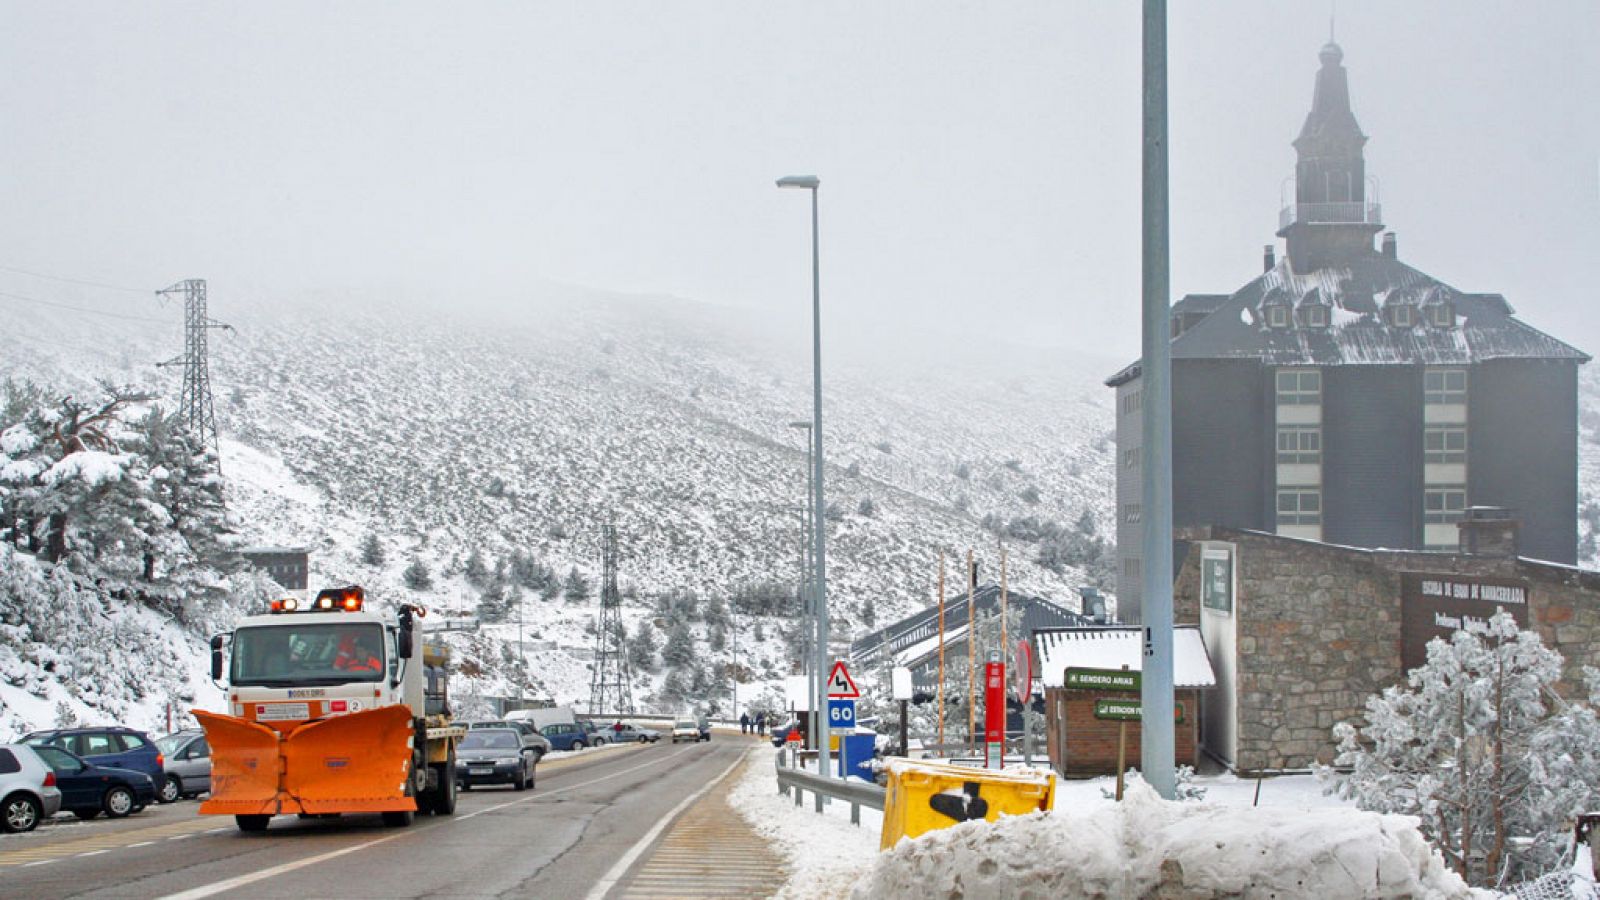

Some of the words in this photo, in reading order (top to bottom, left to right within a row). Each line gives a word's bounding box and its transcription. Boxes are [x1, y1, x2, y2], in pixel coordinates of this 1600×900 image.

[1080, 674, 1111, 684] SENDERO
[352, 702, 358, 710] 2
[831, 707, 852, 721] 60
